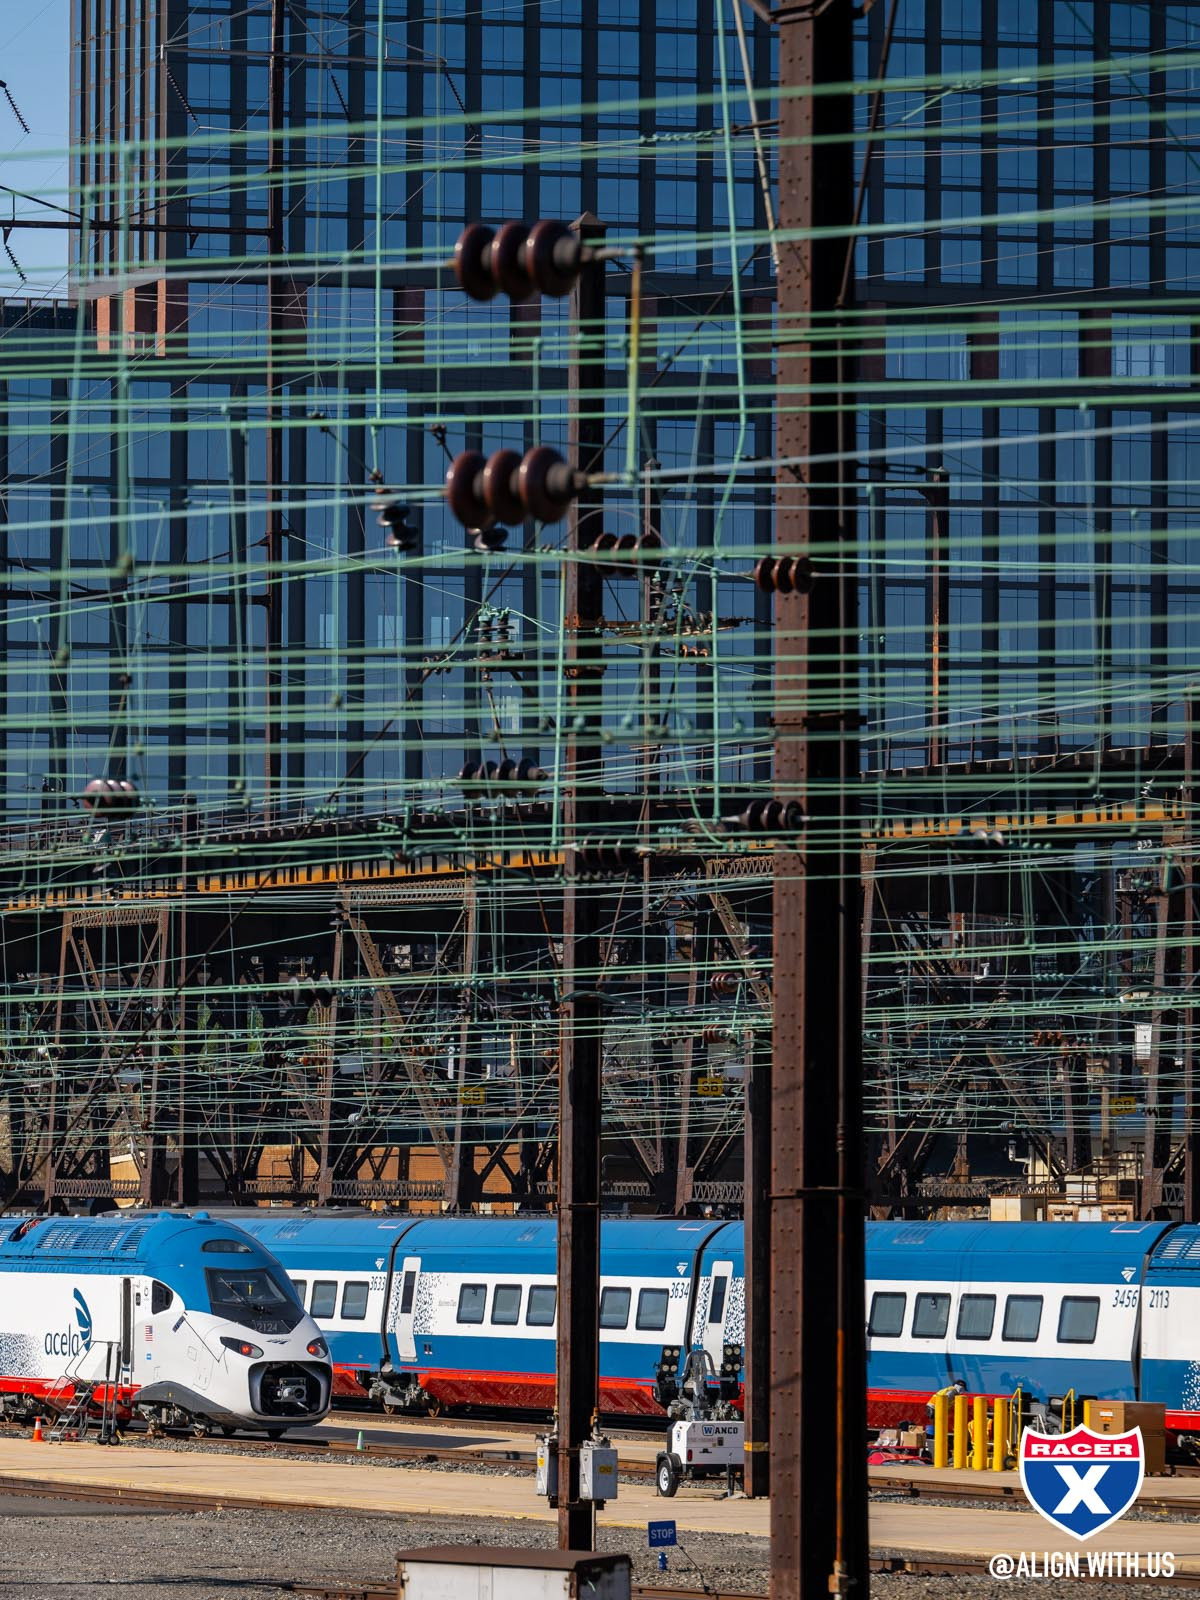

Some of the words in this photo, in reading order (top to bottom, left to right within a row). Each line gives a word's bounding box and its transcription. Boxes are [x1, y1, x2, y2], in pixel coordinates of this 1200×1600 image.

[670, 1282, 689, 1298] 3634
[1112, 1289, 1138, 1308] 3456
[1149, 1289, 1170, 1308] 2113
[256, 1322, 278, 1332] 2124
[44, 1323, 80, 1357] acela
[703, 1425, 739, 1435] WANCO
[650, 1528, 674, 1539] STOP
